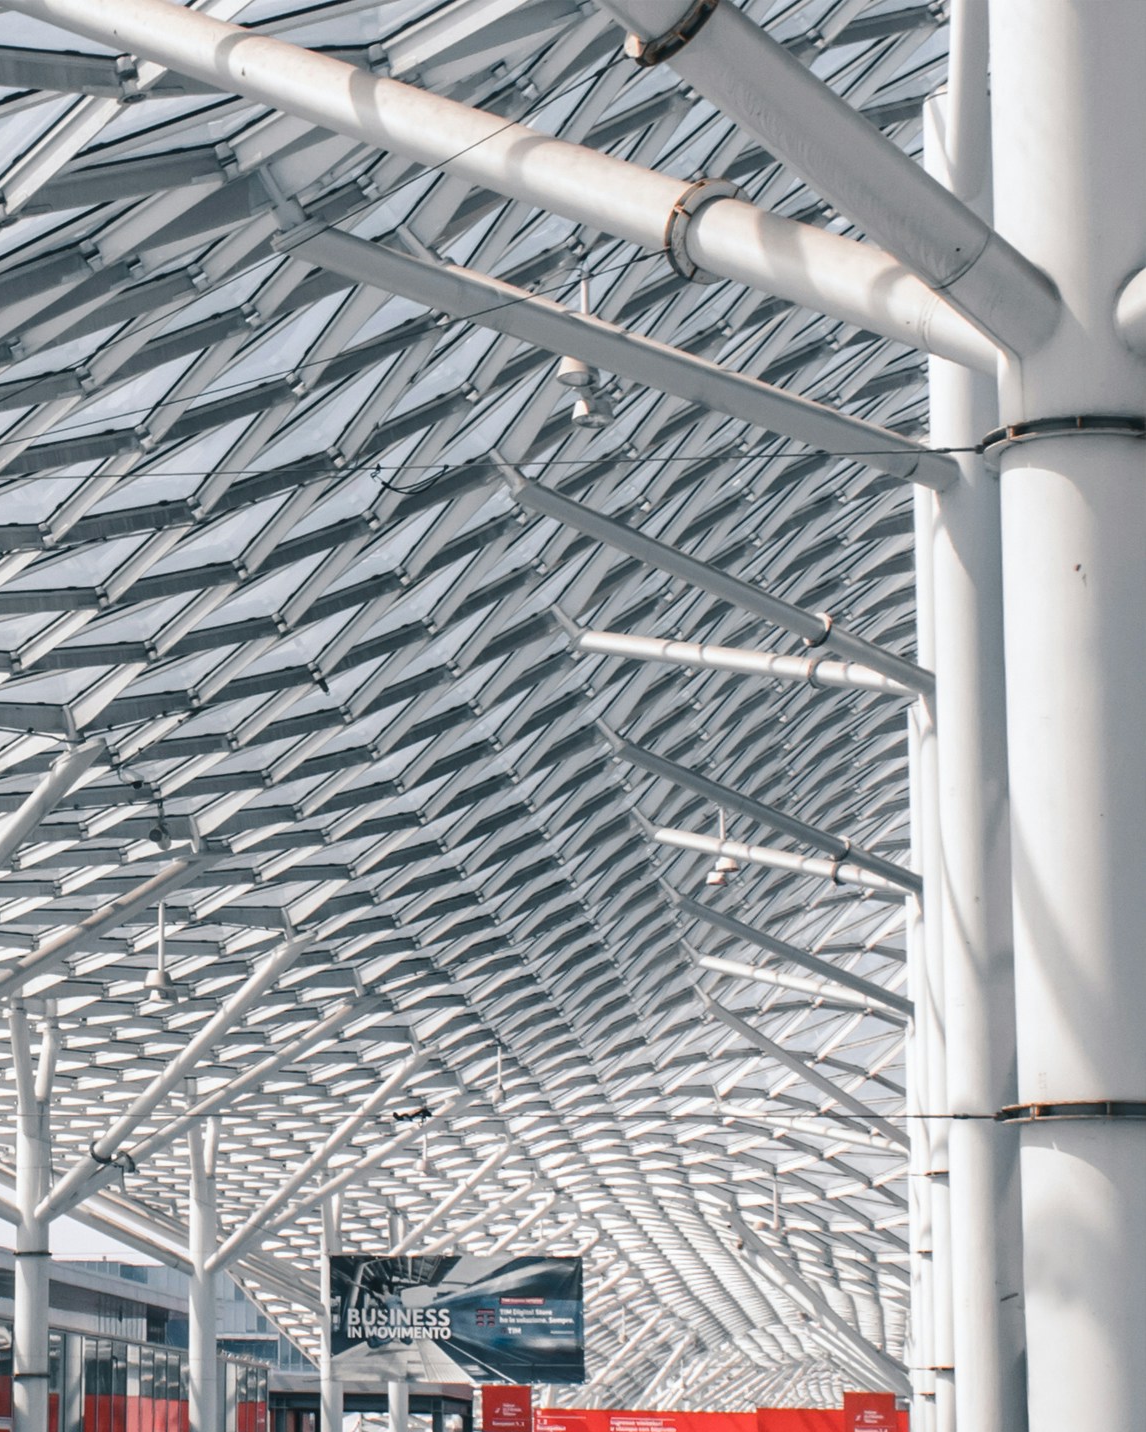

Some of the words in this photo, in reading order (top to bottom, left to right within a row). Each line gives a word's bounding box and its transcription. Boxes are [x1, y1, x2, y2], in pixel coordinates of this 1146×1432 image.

[347, 1308, 451, 1326] BUSINESS
[347, 1326, 362, 1338] IN
[365, 1326, 451, 1339] MOVIMENTO
